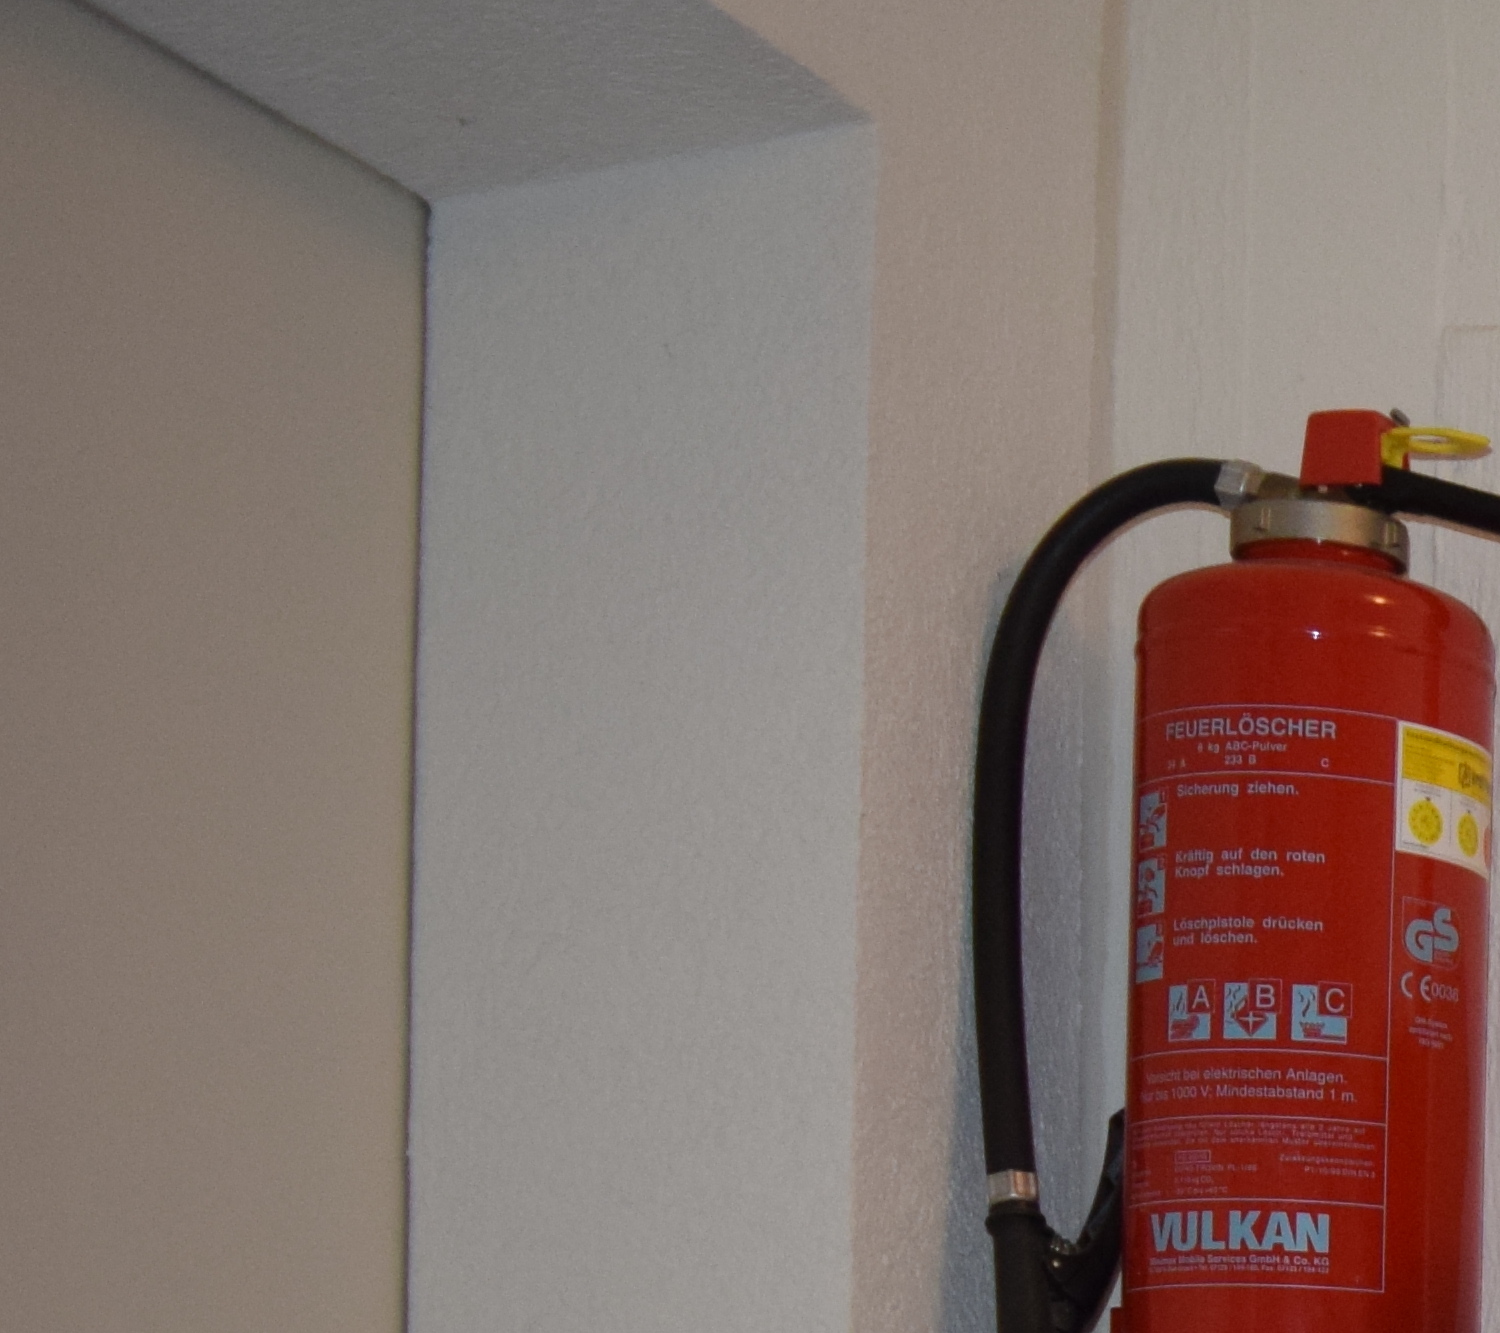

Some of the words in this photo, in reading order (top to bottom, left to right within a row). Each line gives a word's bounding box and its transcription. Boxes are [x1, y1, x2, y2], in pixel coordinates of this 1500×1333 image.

[1166, 712, 1337, 740] FEUERLÖSCHER
[1207, 742, 1220, 754] kg
[1225, 741, 1288, 753] ABC-Pulver
[1320, 757, 1330, 769] C
[1177, 783, 1239, 797] Sicherung
[1247, 783, 1300, 796] ziehen.
[1175, 849, 1214, 864] Kräftig
[1221, 848, 1244, 861] auf
[1250, 849, 1277, 861] den
[1286, 851, 1326, 864] roten
[1175, 864, 1209, 878] Knopf
[1216, 863, 1285, 878] schlagen.
[1173, 916, 1255, 932] Löschpistole
[1262, 916, 1325, 932] drücken
[1173, 934, 1195, 946] und
[1200, 931, 1258, 944] löschen.
[1404, 907, 1459, 963] GS
[1191, 985, 1210, 1010] A
[1255, 984, 1276, 1009] B
[1324, 988, 1346, 1013] C
[1183, 1067, 1200, 1081] bei
[1203, 1066, 1280, 1081] elektrischen
[1286, 1067, 1348, 1085] Anlagen.
[1171, 1085, 1198, 1100] 1000
[1216, 1083, 1324, 1101] Mindestabstand
[1328, 1087, 1336, 1100] 1
[1341, 1089, 1358, 1102] m.
[1150, 1210, 1330, 1254] VULKAN
[1207, 1253, 1247, 1265] Services
[1249, 1253, 1281, 1265] GmbH
[1293, 1256, 1312, 1267] Co.
[1313, 1256, 1330, 1267] KG
